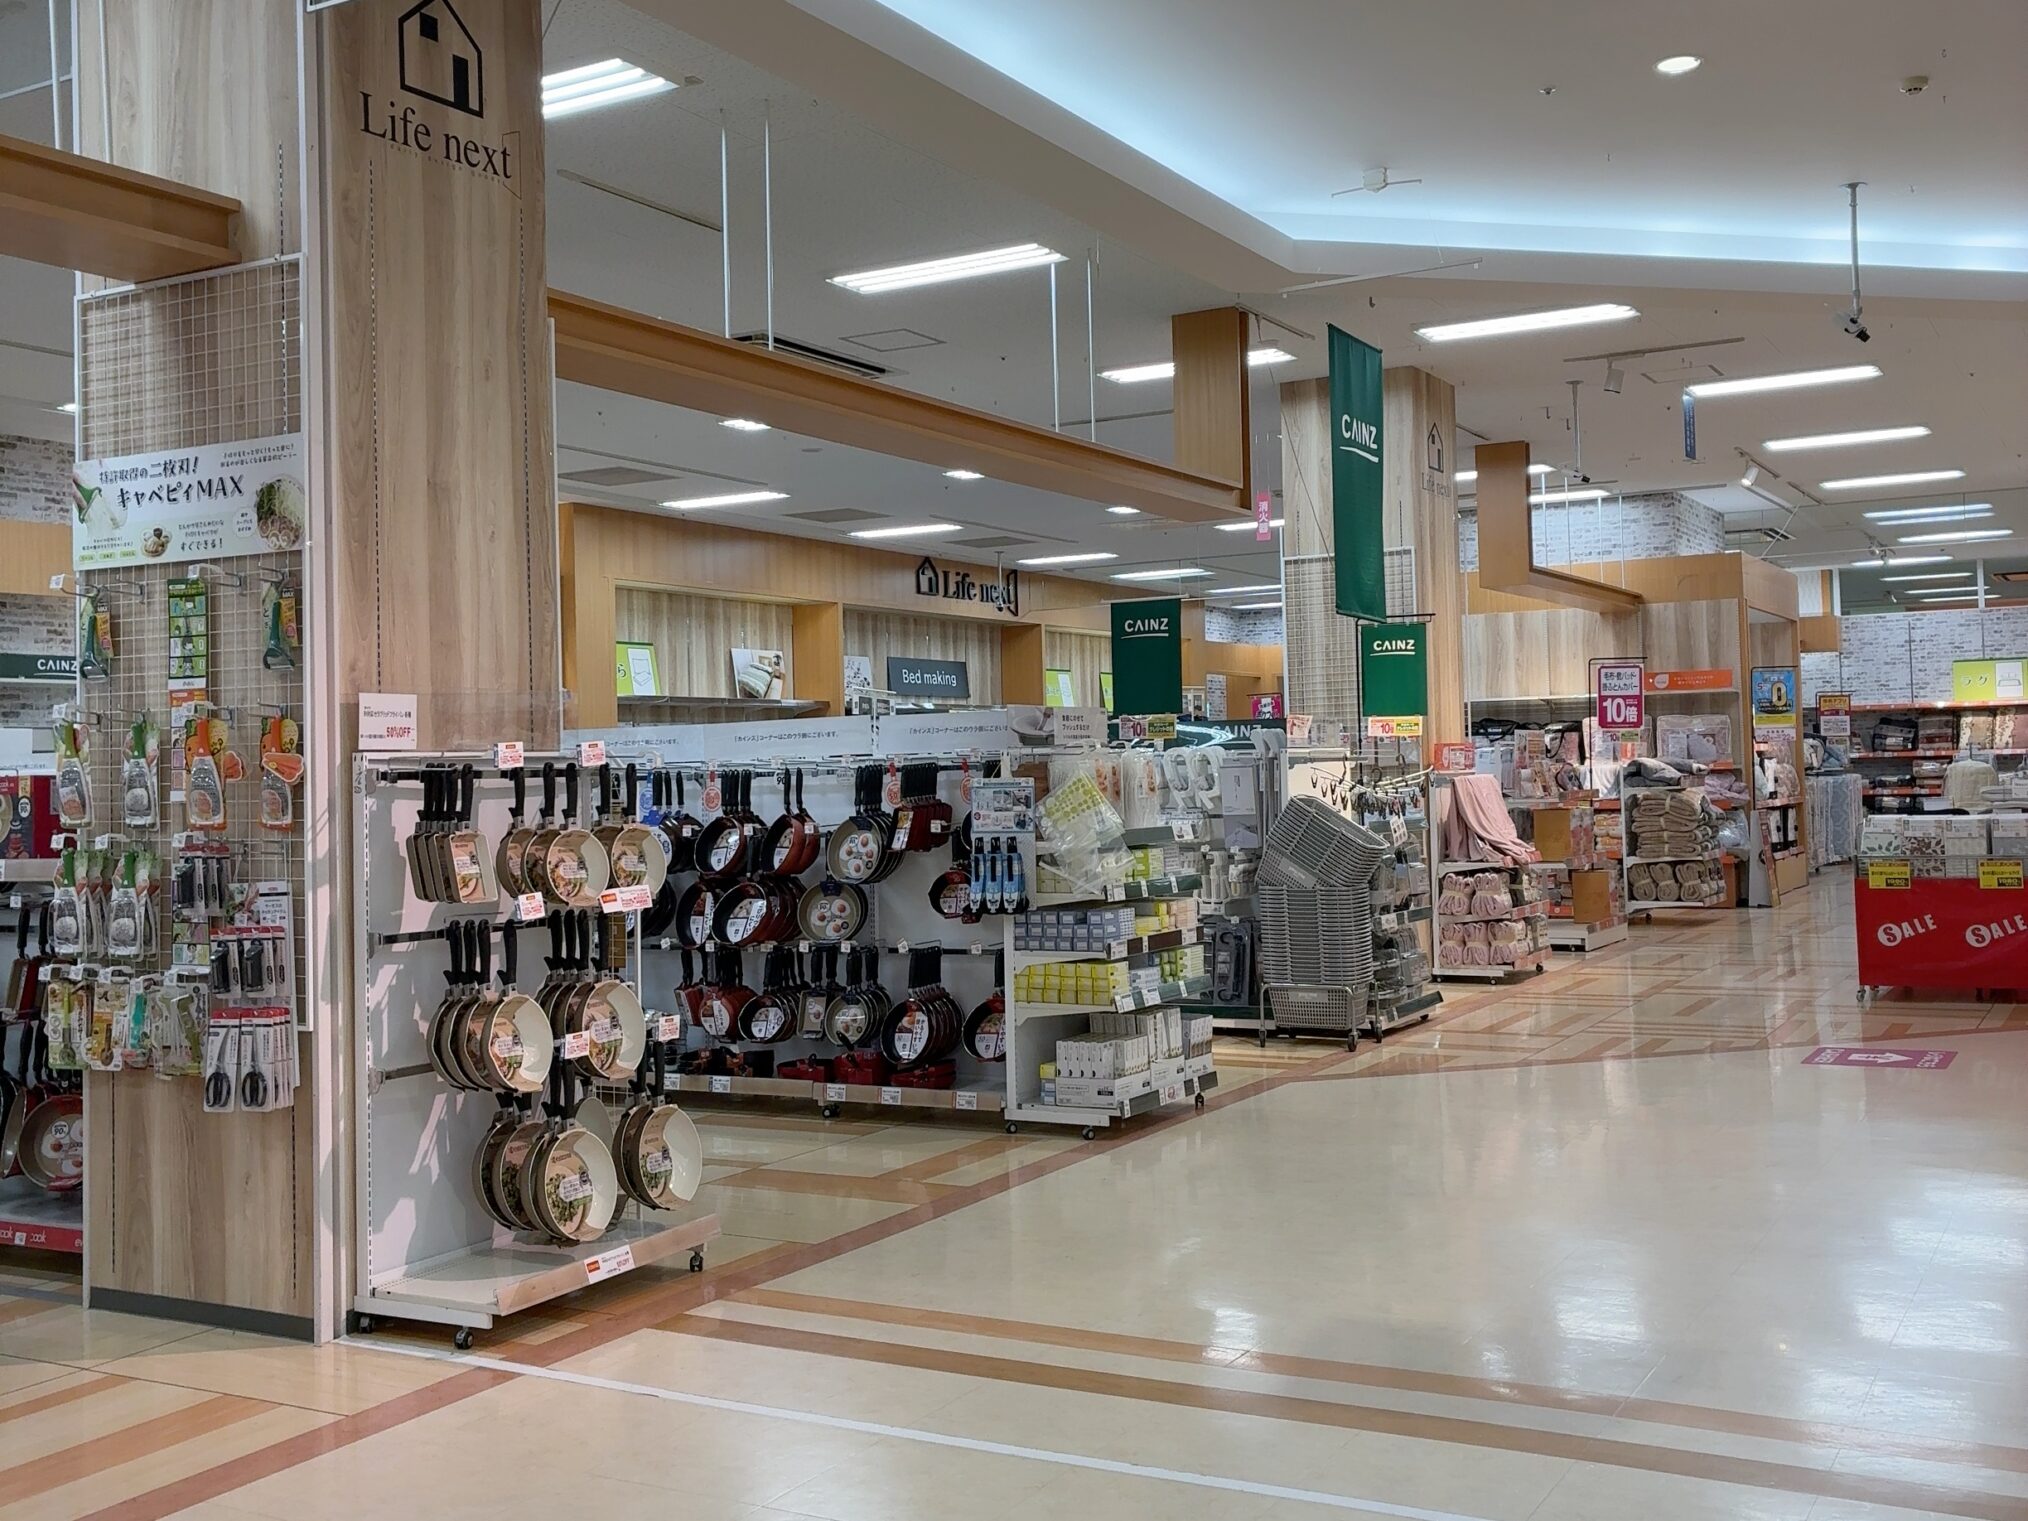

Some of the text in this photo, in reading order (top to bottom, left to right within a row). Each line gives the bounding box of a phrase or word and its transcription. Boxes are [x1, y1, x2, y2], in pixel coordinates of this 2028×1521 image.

[360, 91, 432, 151] Life
[443, 132, 512, 179] next
[1341, 414, 1378, 449] CAINZ
[942, 569, 977, 601] Life
[1125, 618, 1169, 633] CAINZ
[1373, 639, 1415, 651] CAINZ
[37, 658, 78, 672] CAINZ
[902, 669, 957, 687] Bed making
[386, 726, 411, 738] 50%OFF
[1882, 914, 1937, 943] SALE
[1970, 914, 2027, 945] SALE
